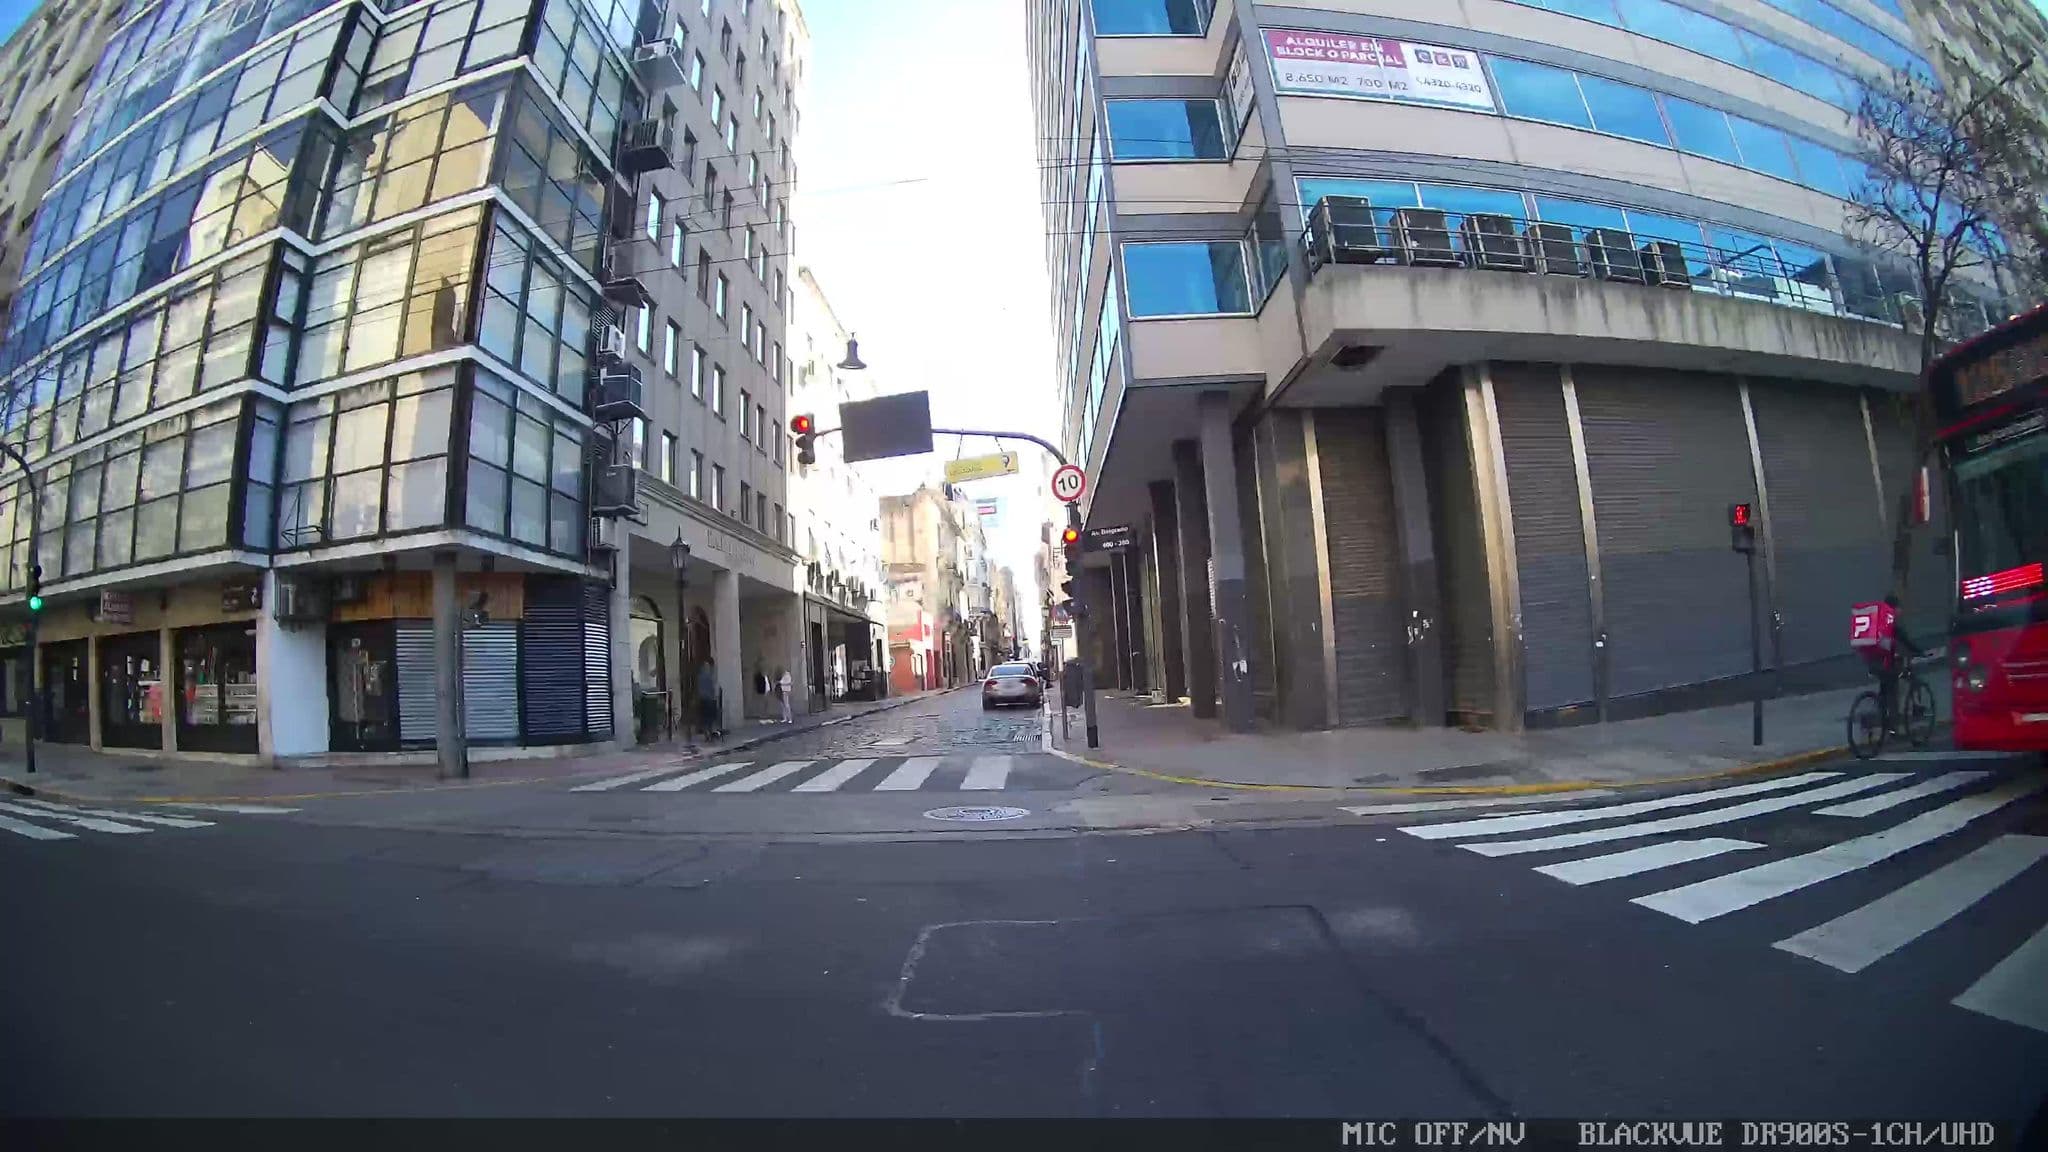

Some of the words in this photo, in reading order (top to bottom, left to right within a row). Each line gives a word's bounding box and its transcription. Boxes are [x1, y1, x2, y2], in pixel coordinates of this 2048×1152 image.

[1276, 46, 1325, 58] BLOCK
[1327, 48, 1339, 58] O
[1286, 36, 1357, 51] ALQUILER
[1361, 42, 1384, 53] EN
[1285, 72, 1323, 83] 8.650
[1328, 75, 1349, 85] M2
[1356, 77, 1383, 88] 700
[1388, 80, 1408, 91] M2
[1058, 474, 1079, 493] 10
[1854, 616, 1870, 638] P
